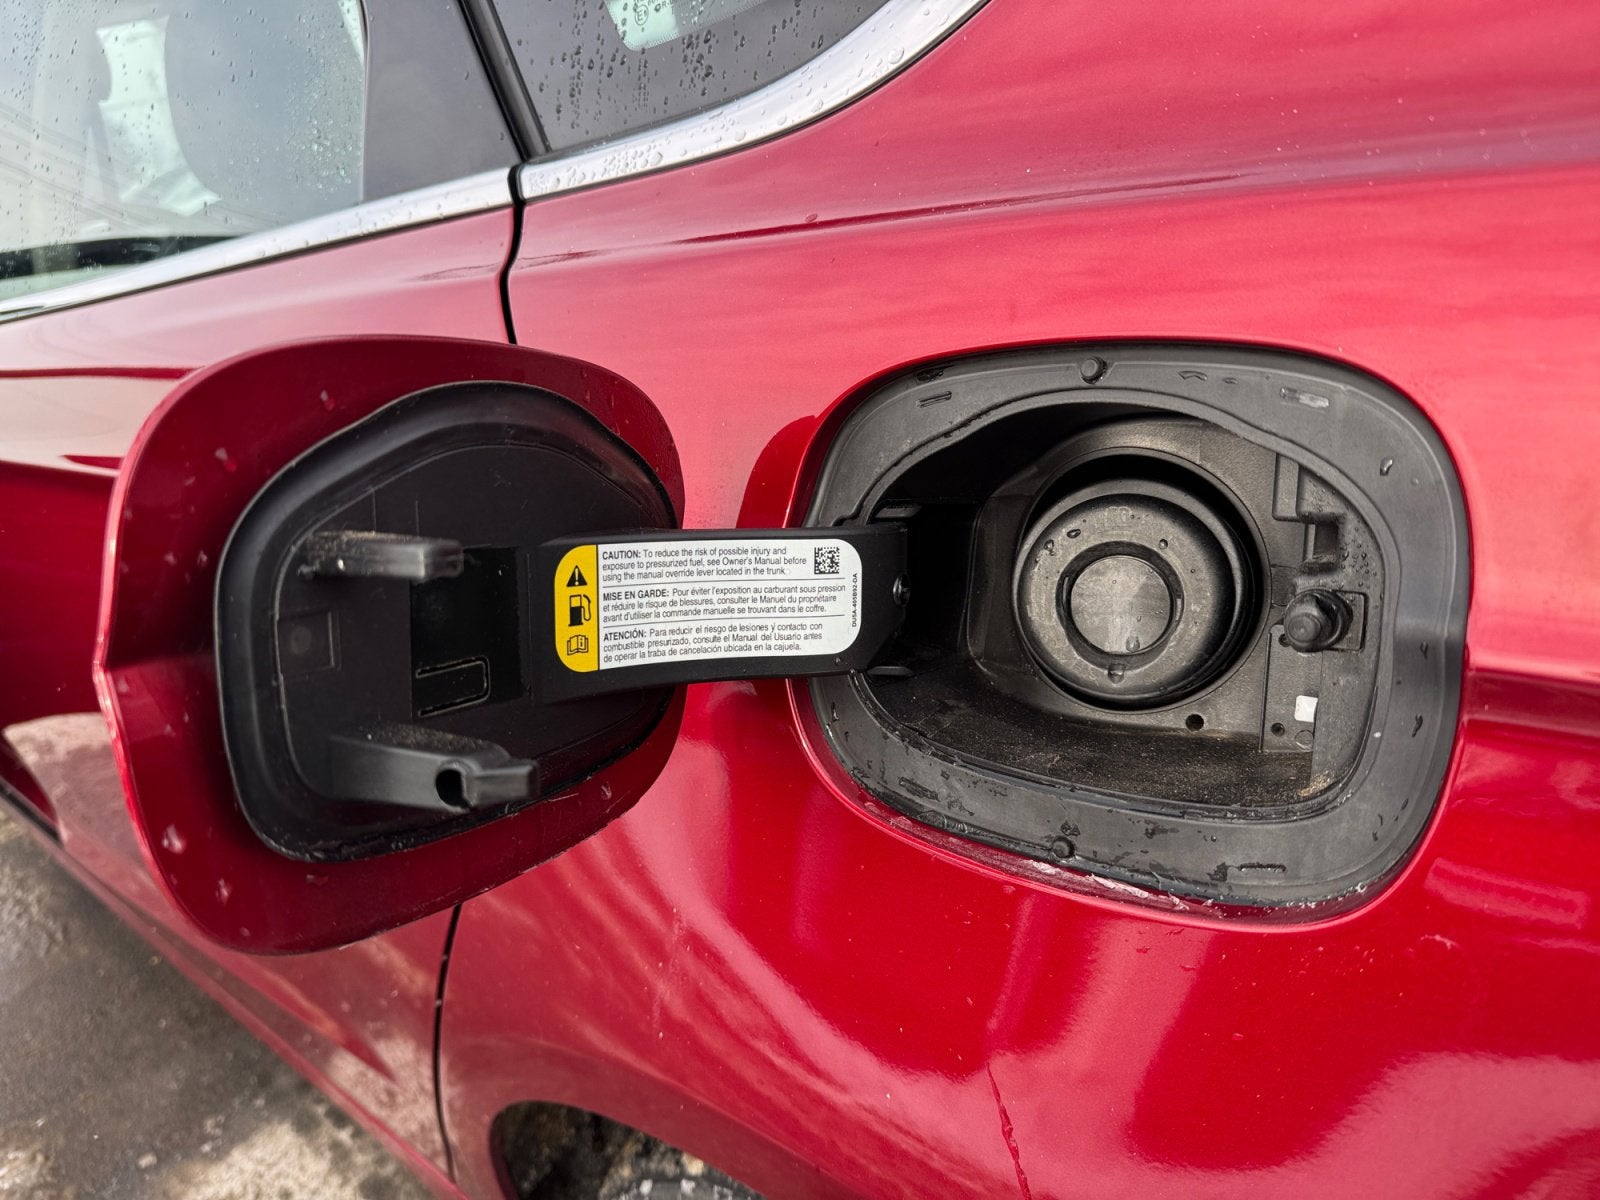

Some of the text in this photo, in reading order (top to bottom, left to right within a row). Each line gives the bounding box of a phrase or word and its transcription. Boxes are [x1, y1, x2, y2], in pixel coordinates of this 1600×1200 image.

[602, 547, 787, 560] CAUTION: To reduce the risk of possible injury and
[602, 561, 635, 572] exposure
[646, 559, 687, 570] pressurized
[689, 558, 705, 567] fuel,
[707, 558, 720, 566] see
[722, 557, 752, 566] Owner's
[754, 557, 781, 565] Manual
[783, 556, 806, 564] before
[602, 572, 621, 583] using
[624, 572, 635, 580] the
[637, 571, 663, 579] manual
[665, 569, 694, 578] override
[697, 568, 714, 576] lever
[716, 567, 742, 576] located
[745, 567, 751, 575] in
[753, 567, 764, 575] the
[602, 592, 622, 601] MISE
[625, 591, 636, 599] EN
[637, 589, 670, 599] GARDE:
[672, 588, 689, 597] Pour
[691, 587, 710, 596] éviter
[711, 586, 751, 596] l'exposition
[817, 584, 846, 594] pression
[603, 604, 610, 612] et
[611, 603, 635, 611] réduire
[646, 600, 667, 610] risque
[669, 599, 677, 607] de
[680, 598, 714, 606] blessures,
[717, 596, 749, 605] consulter
[751, 596, 758, 604] le
[760, 595, 786, 604] Manuel
[788, 595, 797, 603] du
[798, 594, 836, 604] propriétaire
[603, 613, 622, 623] avant
[624, 611, 652, 621] d'utiliser
[654, 611, 661, 619] la
[663, 608, 701, 618] commande
[703, 606, 735, 615] manuelle
[748, 605, 776, 613] trouvant
[778, 605, 796, 613] dans
[806, 604, 826, 612] coffre.
[603, 629, 647, 640] ATENCIÓN:
[649, 629, 667, 637] Para
[669, 627, 692, 636] reducir
[696, 625, 702, 634] el
[704, 624, 727, 634] riesgo
[728, 624, 738, 632] de
[740, 623, 769, 631] lesiones
[777, 623, 807, 631] contacto
[603, 641, 645, 652] combustible
[648, 637, 691, 648] presurizado,
[693, 634, 721, 644] consulte
[724, 634, 730, 642] el
[732, 633, 757, 642] Manual
[774, 632, 801, 640] Usuario
[803, 632, 822, 640] antes
[603, 654, 612, 663] de
[614, 653, 637, 663] operar
[639, 650, 646, 659] la
[648, 649, 666, 658] traba
[668, 648, 677, 656] de
[680, 645, 721, 655] cancelación
[724, 644, 752, 652] ubicada
[774, 643, 802, 652] cajuela.
